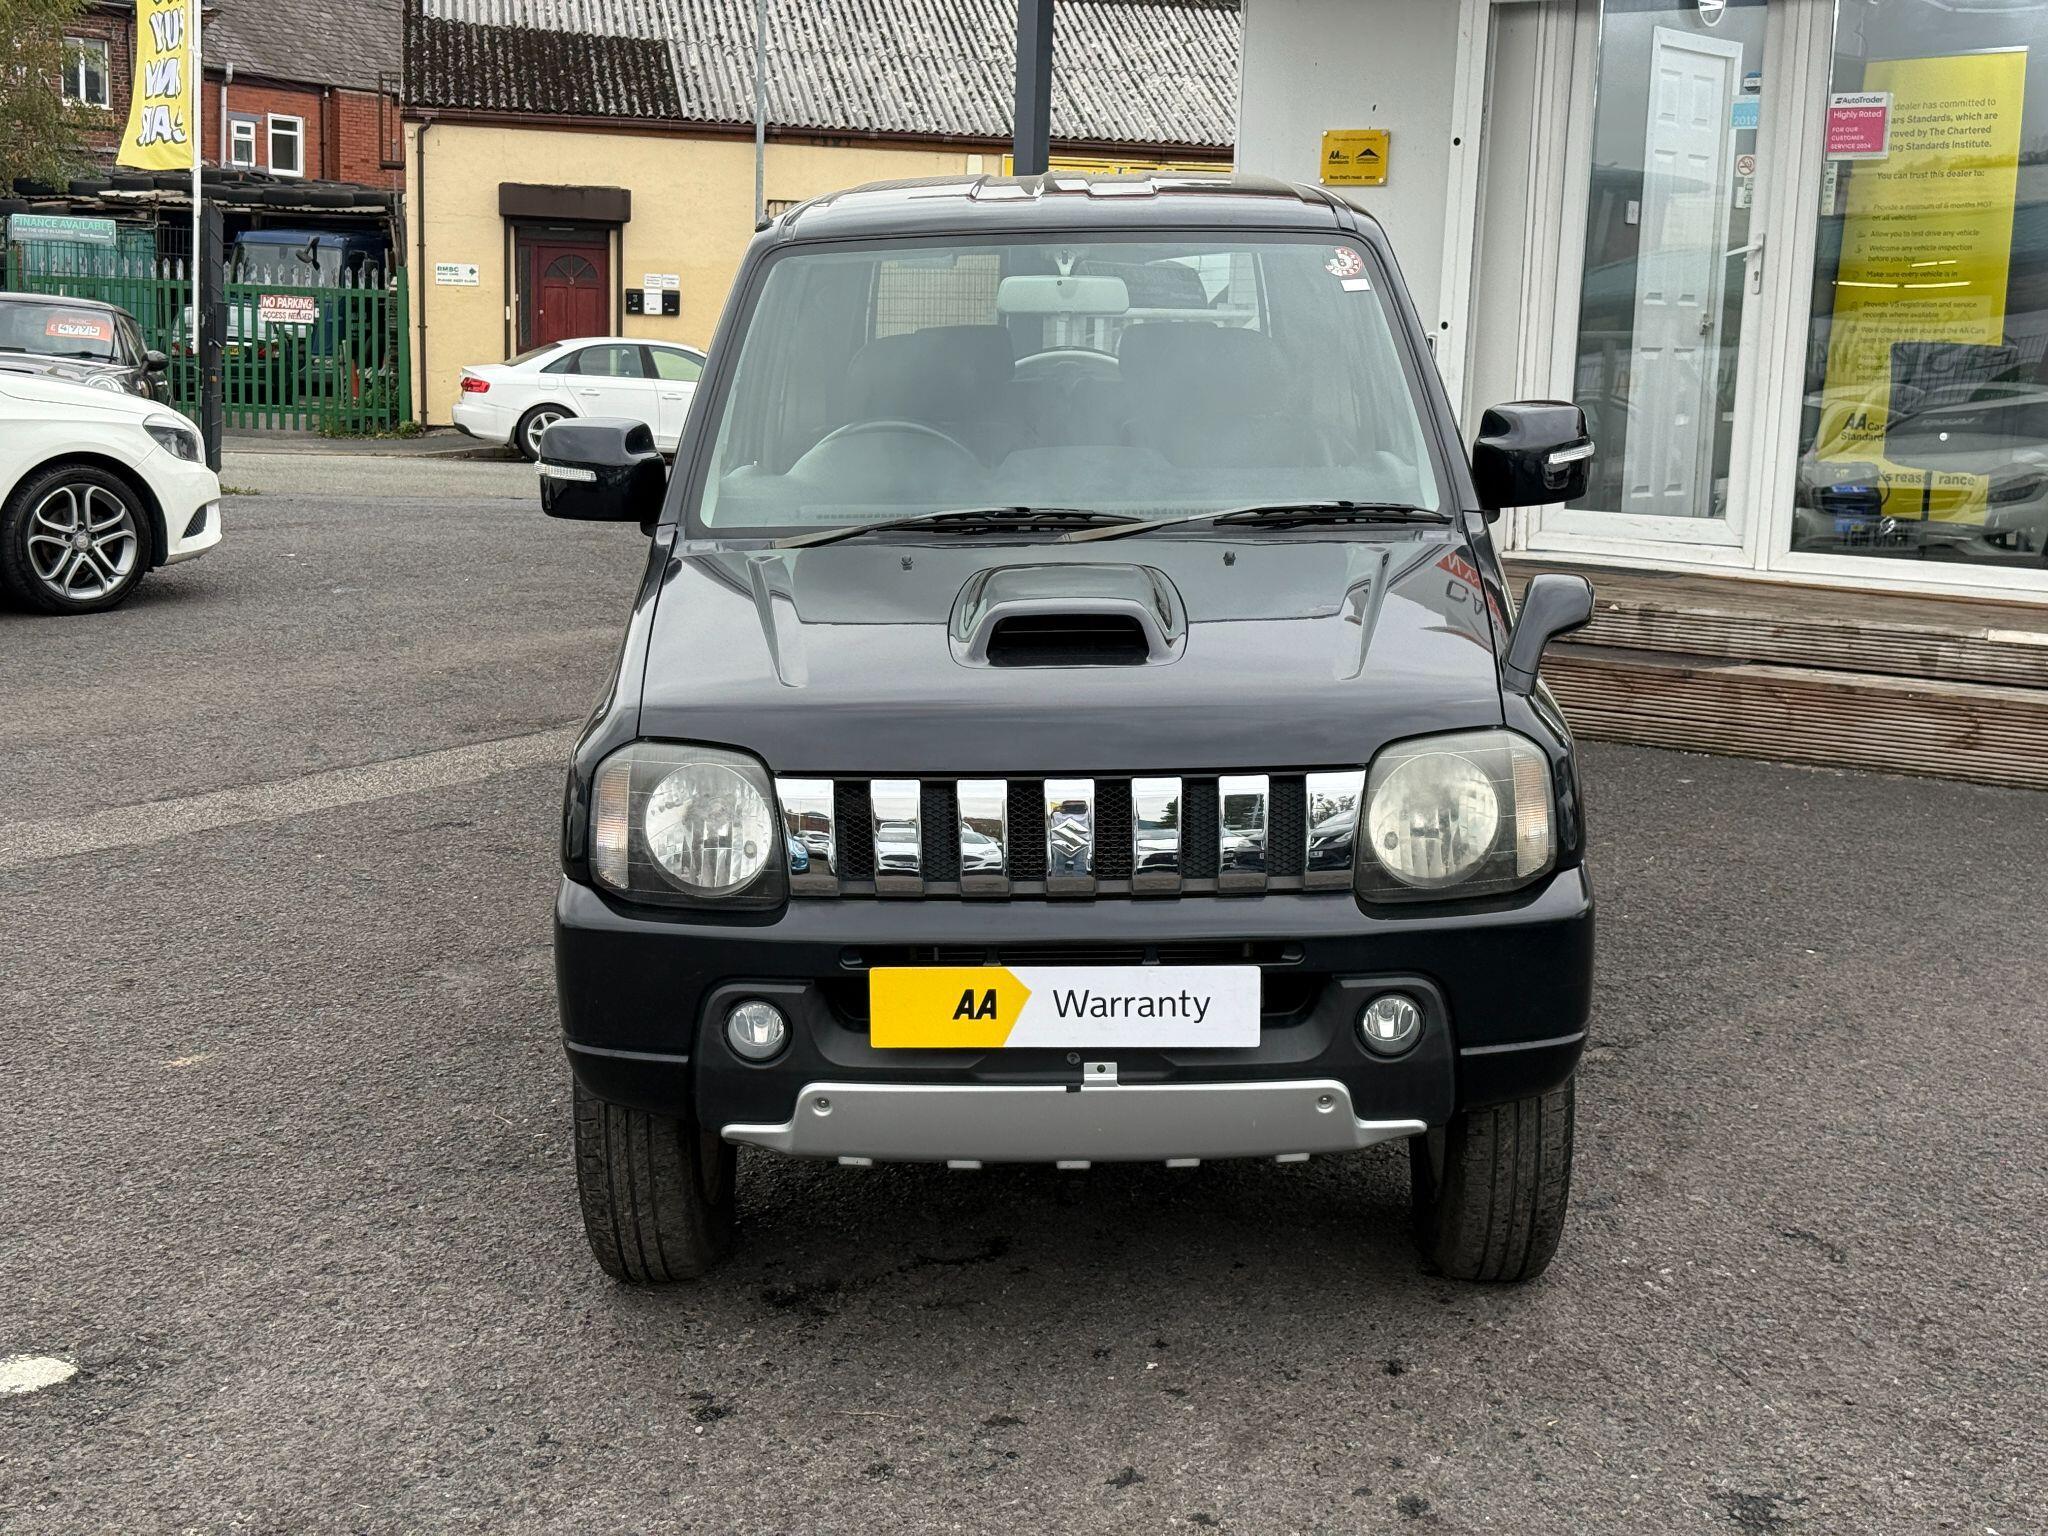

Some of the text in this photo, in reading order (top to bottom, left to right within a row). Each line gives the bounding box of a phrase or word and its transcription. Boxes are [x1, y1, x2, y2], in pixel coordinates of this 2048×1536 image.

[1895, 102, 1920, 111] dealer
[1922, 102, 1937, 110] has
[1940, 98, 1985, 109] committed
[1833, 110, 1882, 120] Highly Rated
[1890, 117, 1905, 125] ars
[1907, 114, 1953, 124] Standards,
[1956, 112, 1981, 121] which
[1890, 125, 1992, 138] roved by The Chartered
[1889, 139, 1992, 152] ing Standards Institute.
[1877, 172, 1891, 180] You
[1909, 171, 1929, 179] trust
[1930, 170, 1944, 178] this
[1946, 170, 1972, 178] dealer
[14, 216, 113, 231] FINANCE AVAILABLE
[1939, 244, 1973, 252] inspection
[262, 296, 313, 310] NO PARKING
[1843, 413, 1885, 431] AA Car
[1840, 432, 1884, 441] Standard
[952, 989, 1211, 1024] AA Warranty
